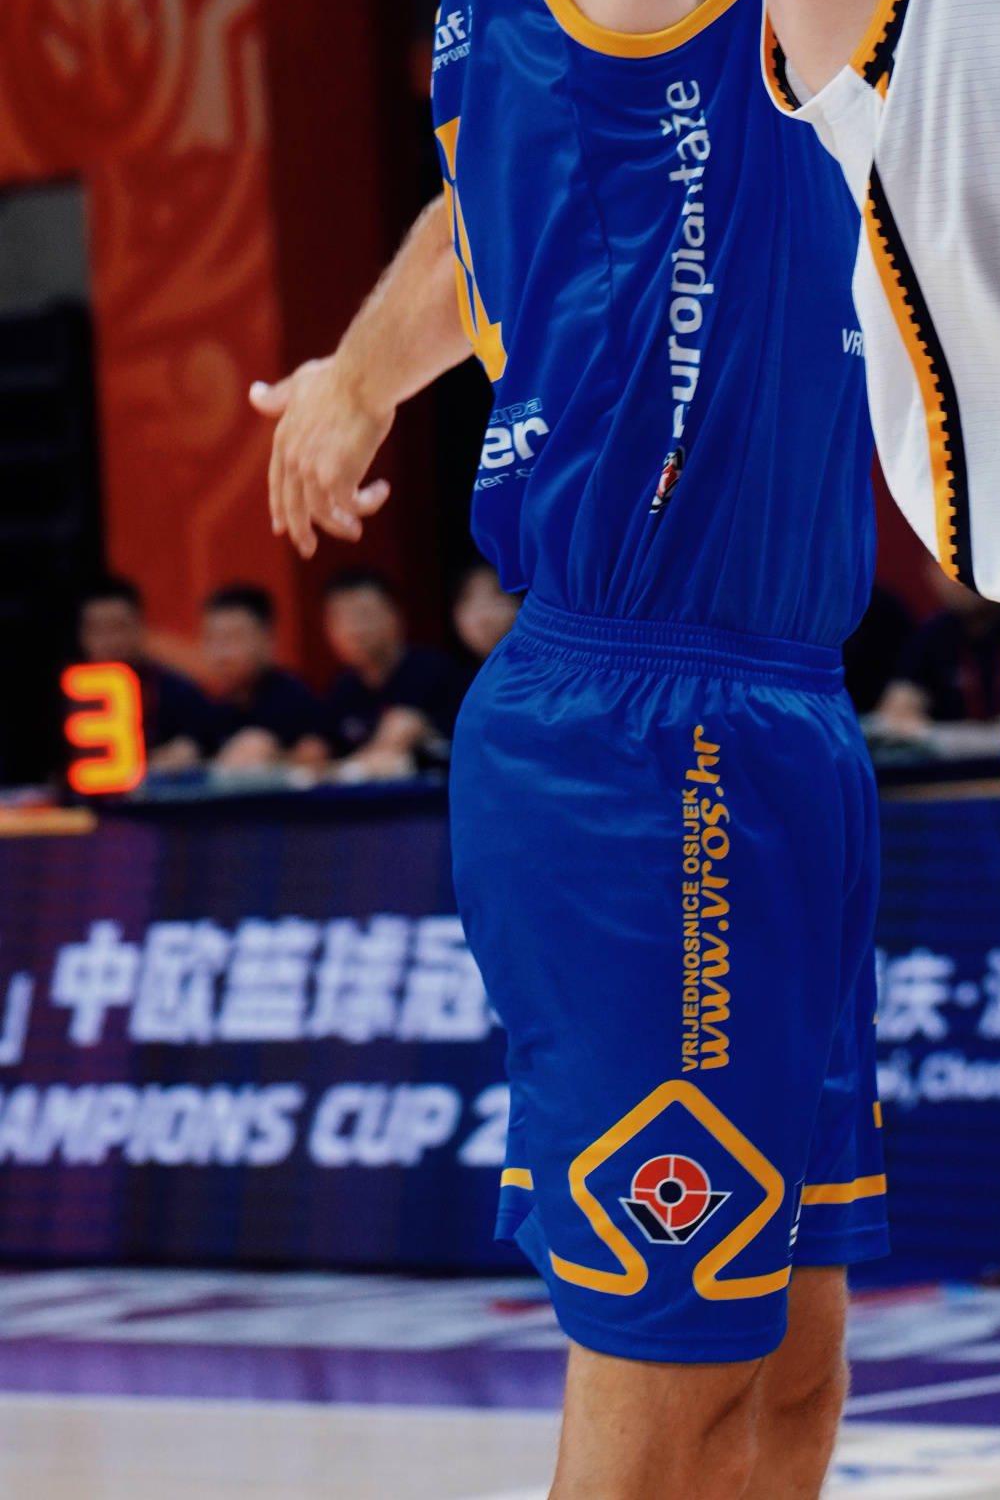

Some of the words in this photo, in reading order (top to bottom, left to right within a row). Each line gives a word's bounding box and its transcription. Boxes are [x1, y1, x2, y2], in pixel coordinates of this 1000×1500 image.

[842, 328, 866, 358] VR
[60, 661, 147, 795] 3
[682, 787, 701, 875] OSIJEK
[685, 724, 731, 1070] www.vros.hr
[681, 881, 700, 1073] VRIJEDNOSNICE
[309, 1084, 462, 1167] CUP
